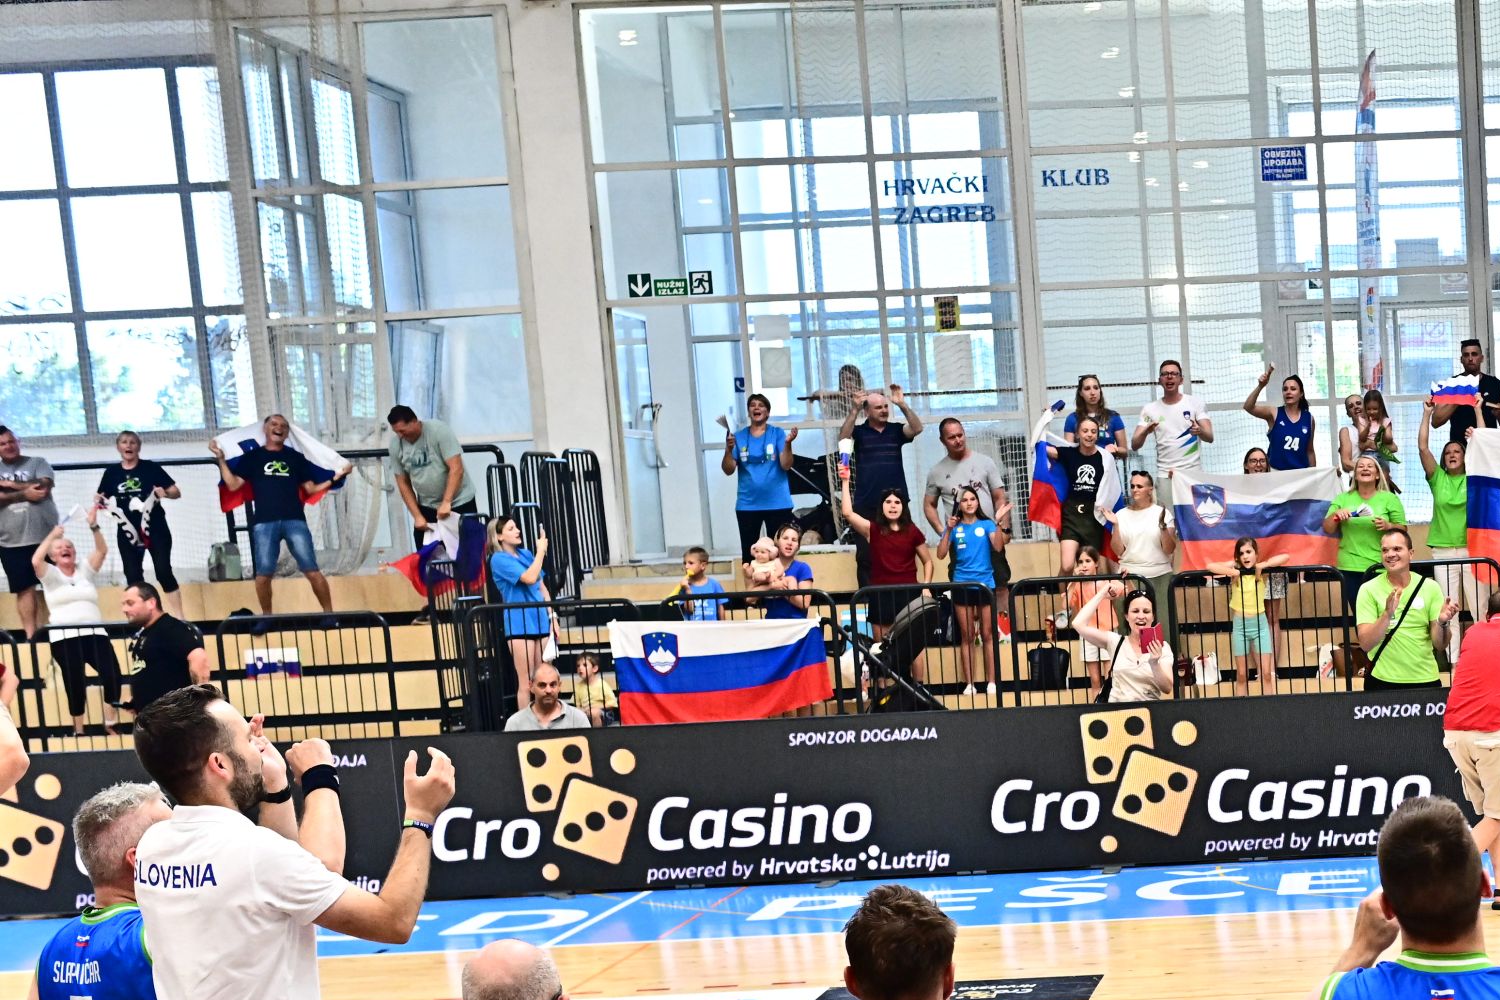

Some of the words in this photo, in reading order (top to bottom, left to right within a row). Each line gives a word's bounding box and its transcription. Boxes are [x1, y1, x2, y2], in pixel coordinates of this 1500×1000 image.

[1264, 150, 1302, 158] OBVEZNA
[1264, 159, 1303, 167] UPORABA
[884, 172, 988, 196] HRVAČKI
[1041, 168, 1110, 188] KLUB
[894, 205, 996, 225] ZAGREB
[656, 280, 685, 289] NUŽNI
[658, 288, 685, 296] IZLAZ
[1283, 435, 1300, 451] 24
[1354, 704, 1420, 719] SPONZOR
[789, 731, 855, 746] SPONZOR
[861, 727, 937, 742] DOGAĐAJA
[991, 779, 1099, 834] Cro
[1207, 764, 1432, 823] Casino
[433, 807, 541, 862] Cro
[647, 793, 873, 852] Casino
[1205, 833, 1284, 855] powered
[1290, 833, 1311, 850] by
[1317, 829, 1378, 848] Hrvat
[134, 863, 217, 889] SLOVENIA
[647, 861, 726, 883] powered
[733, 861, 753, 879] by
[761, 854, 856, 875] Hrvatska
[881, 850, 950, 871] Lutrija
